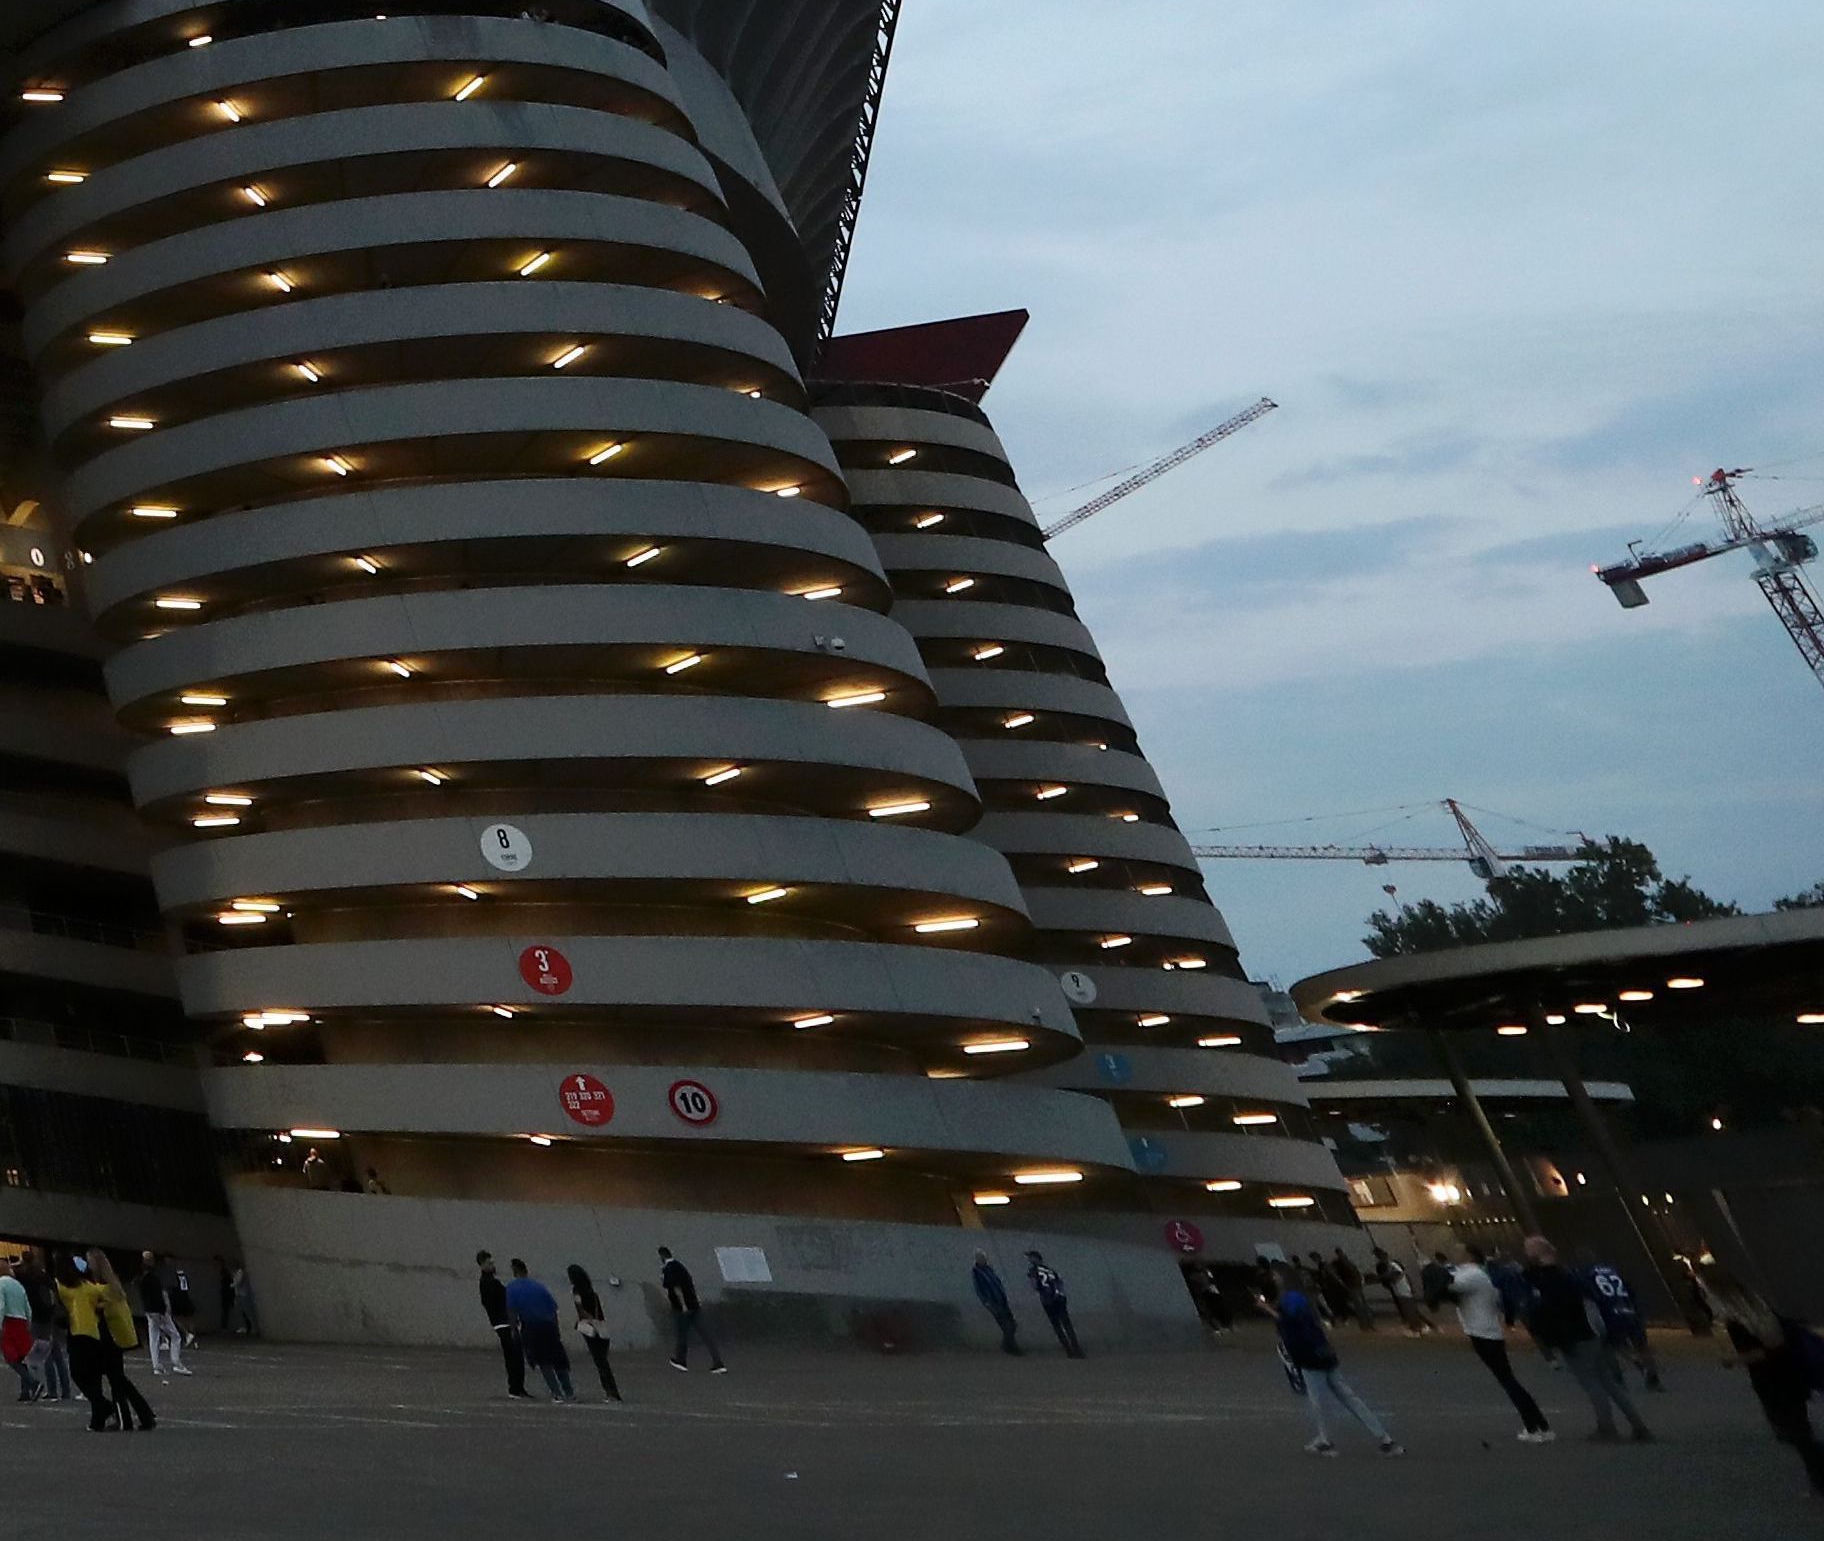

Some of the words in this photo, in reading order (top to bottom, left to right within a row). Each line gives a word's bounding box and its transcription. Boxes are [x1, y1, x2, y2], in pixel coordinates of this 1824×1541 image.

[497, 829, 510, 849] 8
[679, 1092, 706, 1113] 10
[1594, 1274, 1629, 1297] 62
